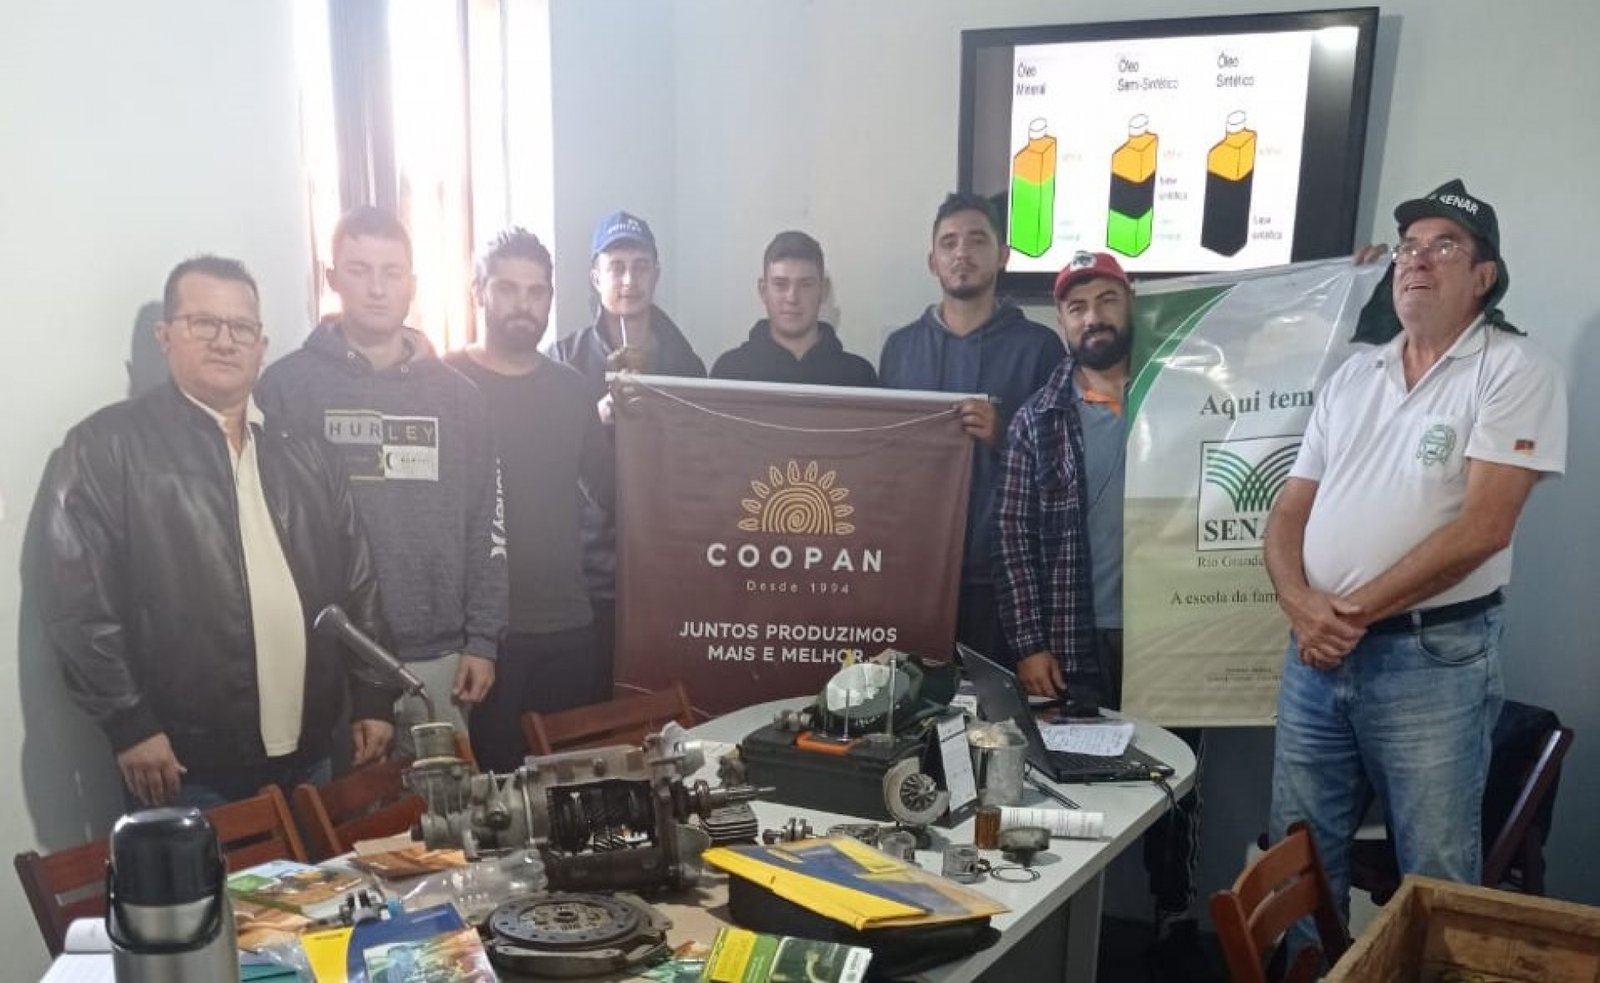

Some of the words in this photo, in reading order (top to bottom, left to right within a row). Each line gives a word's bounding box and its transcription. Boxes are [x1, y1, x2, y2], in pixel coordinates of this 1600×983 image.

[1216, 73, 1255, 88] Sintético
[1200, 390, 1261, 421] Aqui
[329, 421, 435, 442] HURLEY
[1203, 518, 1265, 542] SEN
[706, 543, 883, 572] COOPAN
[1198, 555, 1218, 569] Rio
[746, 580, 799, 593] Desde
[810, 582, 850, 594] 1994
[1170, 591, 1183, 605] A
[1184, 589, 1228, 605] escola
[1231, 589, 1248, 603] da
[679, 621, 759, 640] JUNTOS
[765, 623, 898, 643] PRODUZIMOS
[708, 645, 755, 661] MAIS
[763, 646, 774, 661] E
